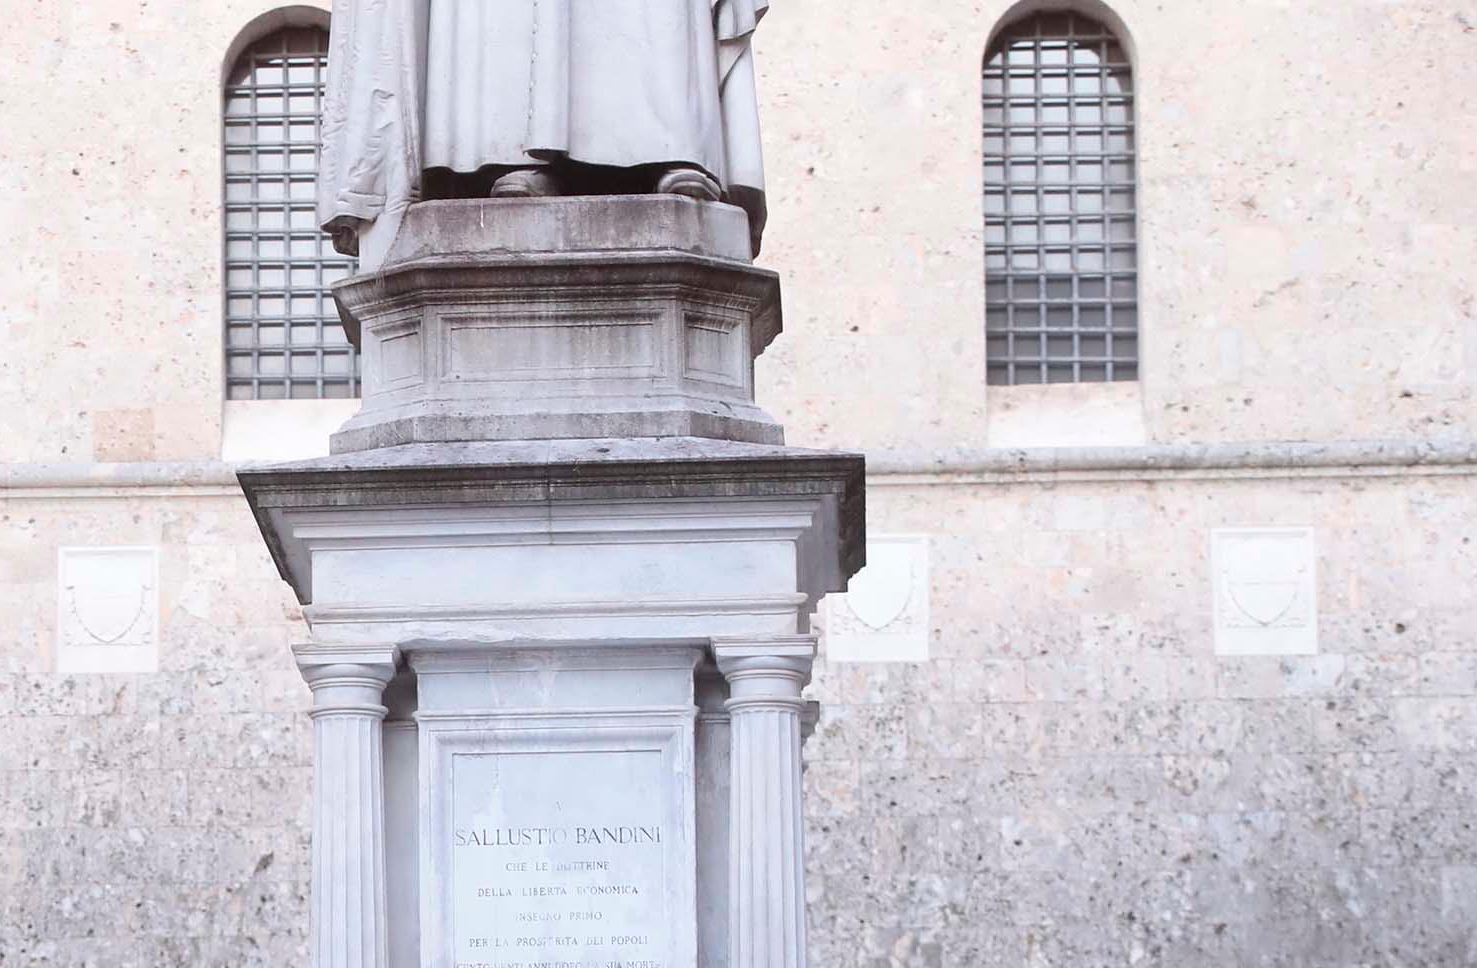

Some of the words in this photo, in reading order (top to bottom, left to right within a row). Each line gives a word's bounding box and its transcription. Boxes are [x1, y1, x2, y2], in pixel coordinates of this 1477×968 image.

[454, 828, 567, 846] SALLUSTIO
[576, 826, 661, 845] BANDINI
[506, 862, 528, 872] CHE
[535, 862, 548, 871] LE
[478, 887, 512, 897] DELLA
[569, 911, 603, 921] PRIMO
[469, 937, 488, 948] PER
[611, 935, 648, 945] POPOLI
